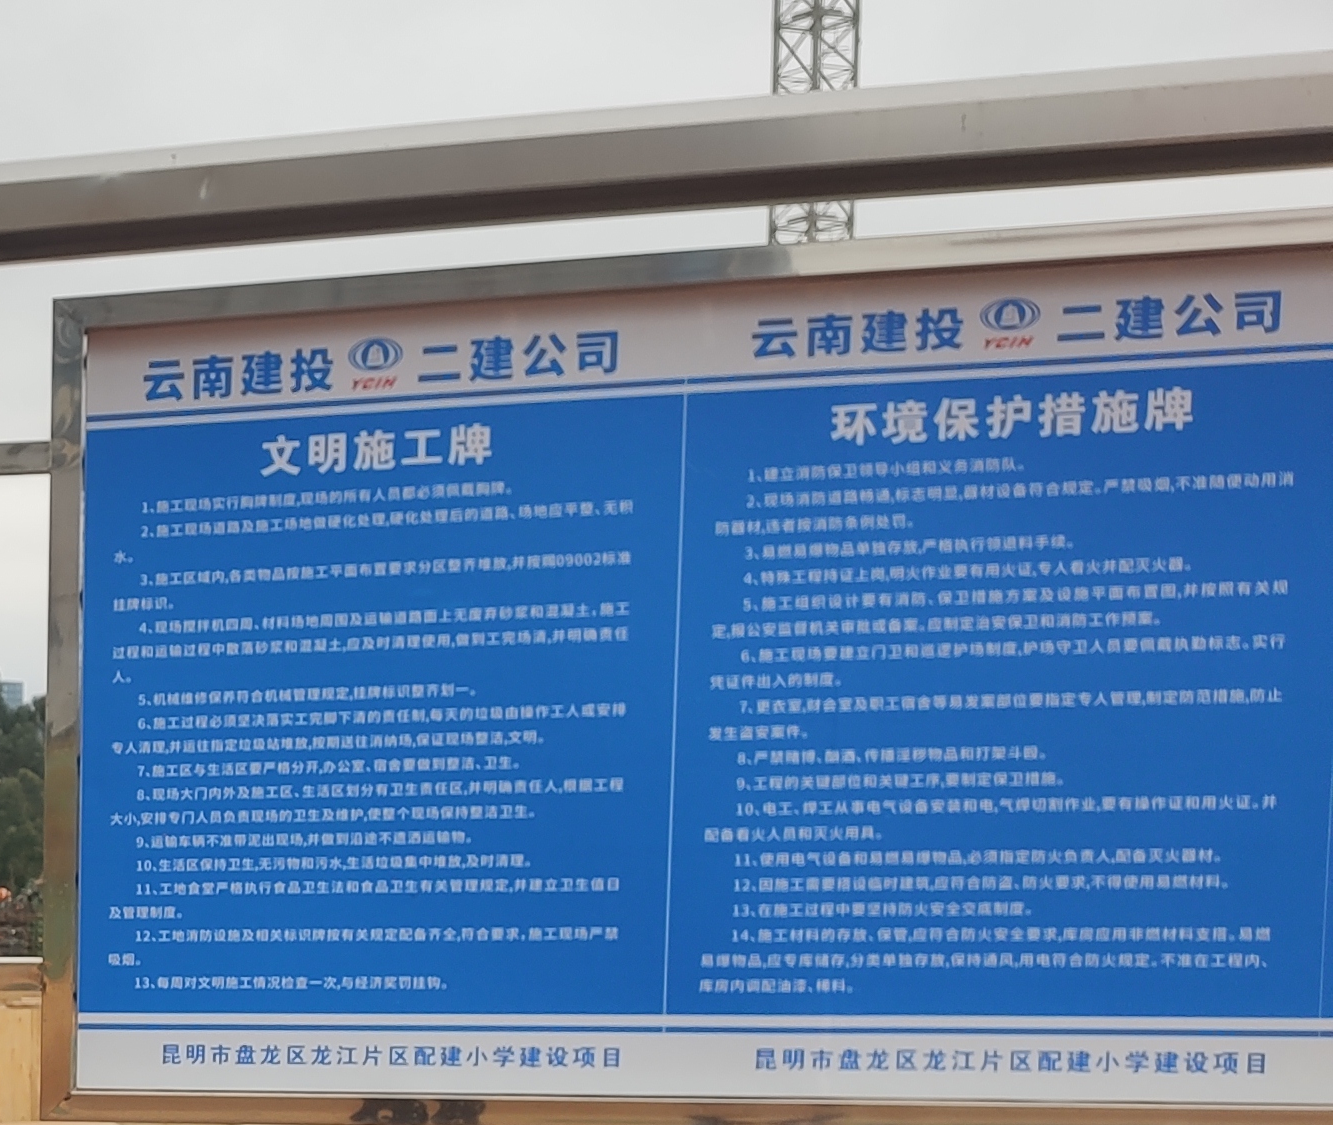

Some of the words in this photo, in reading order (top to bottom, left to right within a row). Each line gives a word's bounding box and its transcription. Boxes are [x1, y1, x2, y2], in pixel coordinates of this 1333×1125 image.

[752, 308, 963, 359] 云南建投
[1056, 290, 1283, 345] 二建公司
[142, 348, 333, 402] 云南建投
[417, 330, 620, 383] 二建公司
[830, 385, 1194, 446] 环境保护措施牌
[260, 423, 493, 477] 文明施工牌
[113, 551, 134, 565] 水。
[112, 671, 132, 684] 人。
[107, 954, 141, 967] 吸烟。
[161, 1044, 622, 1068] 昆明市盘龙区龙江片区配建小学建设项目
[755, 1047, 1268, 1075] 昆明市盘龙区龙江片区配建小学建设项目
